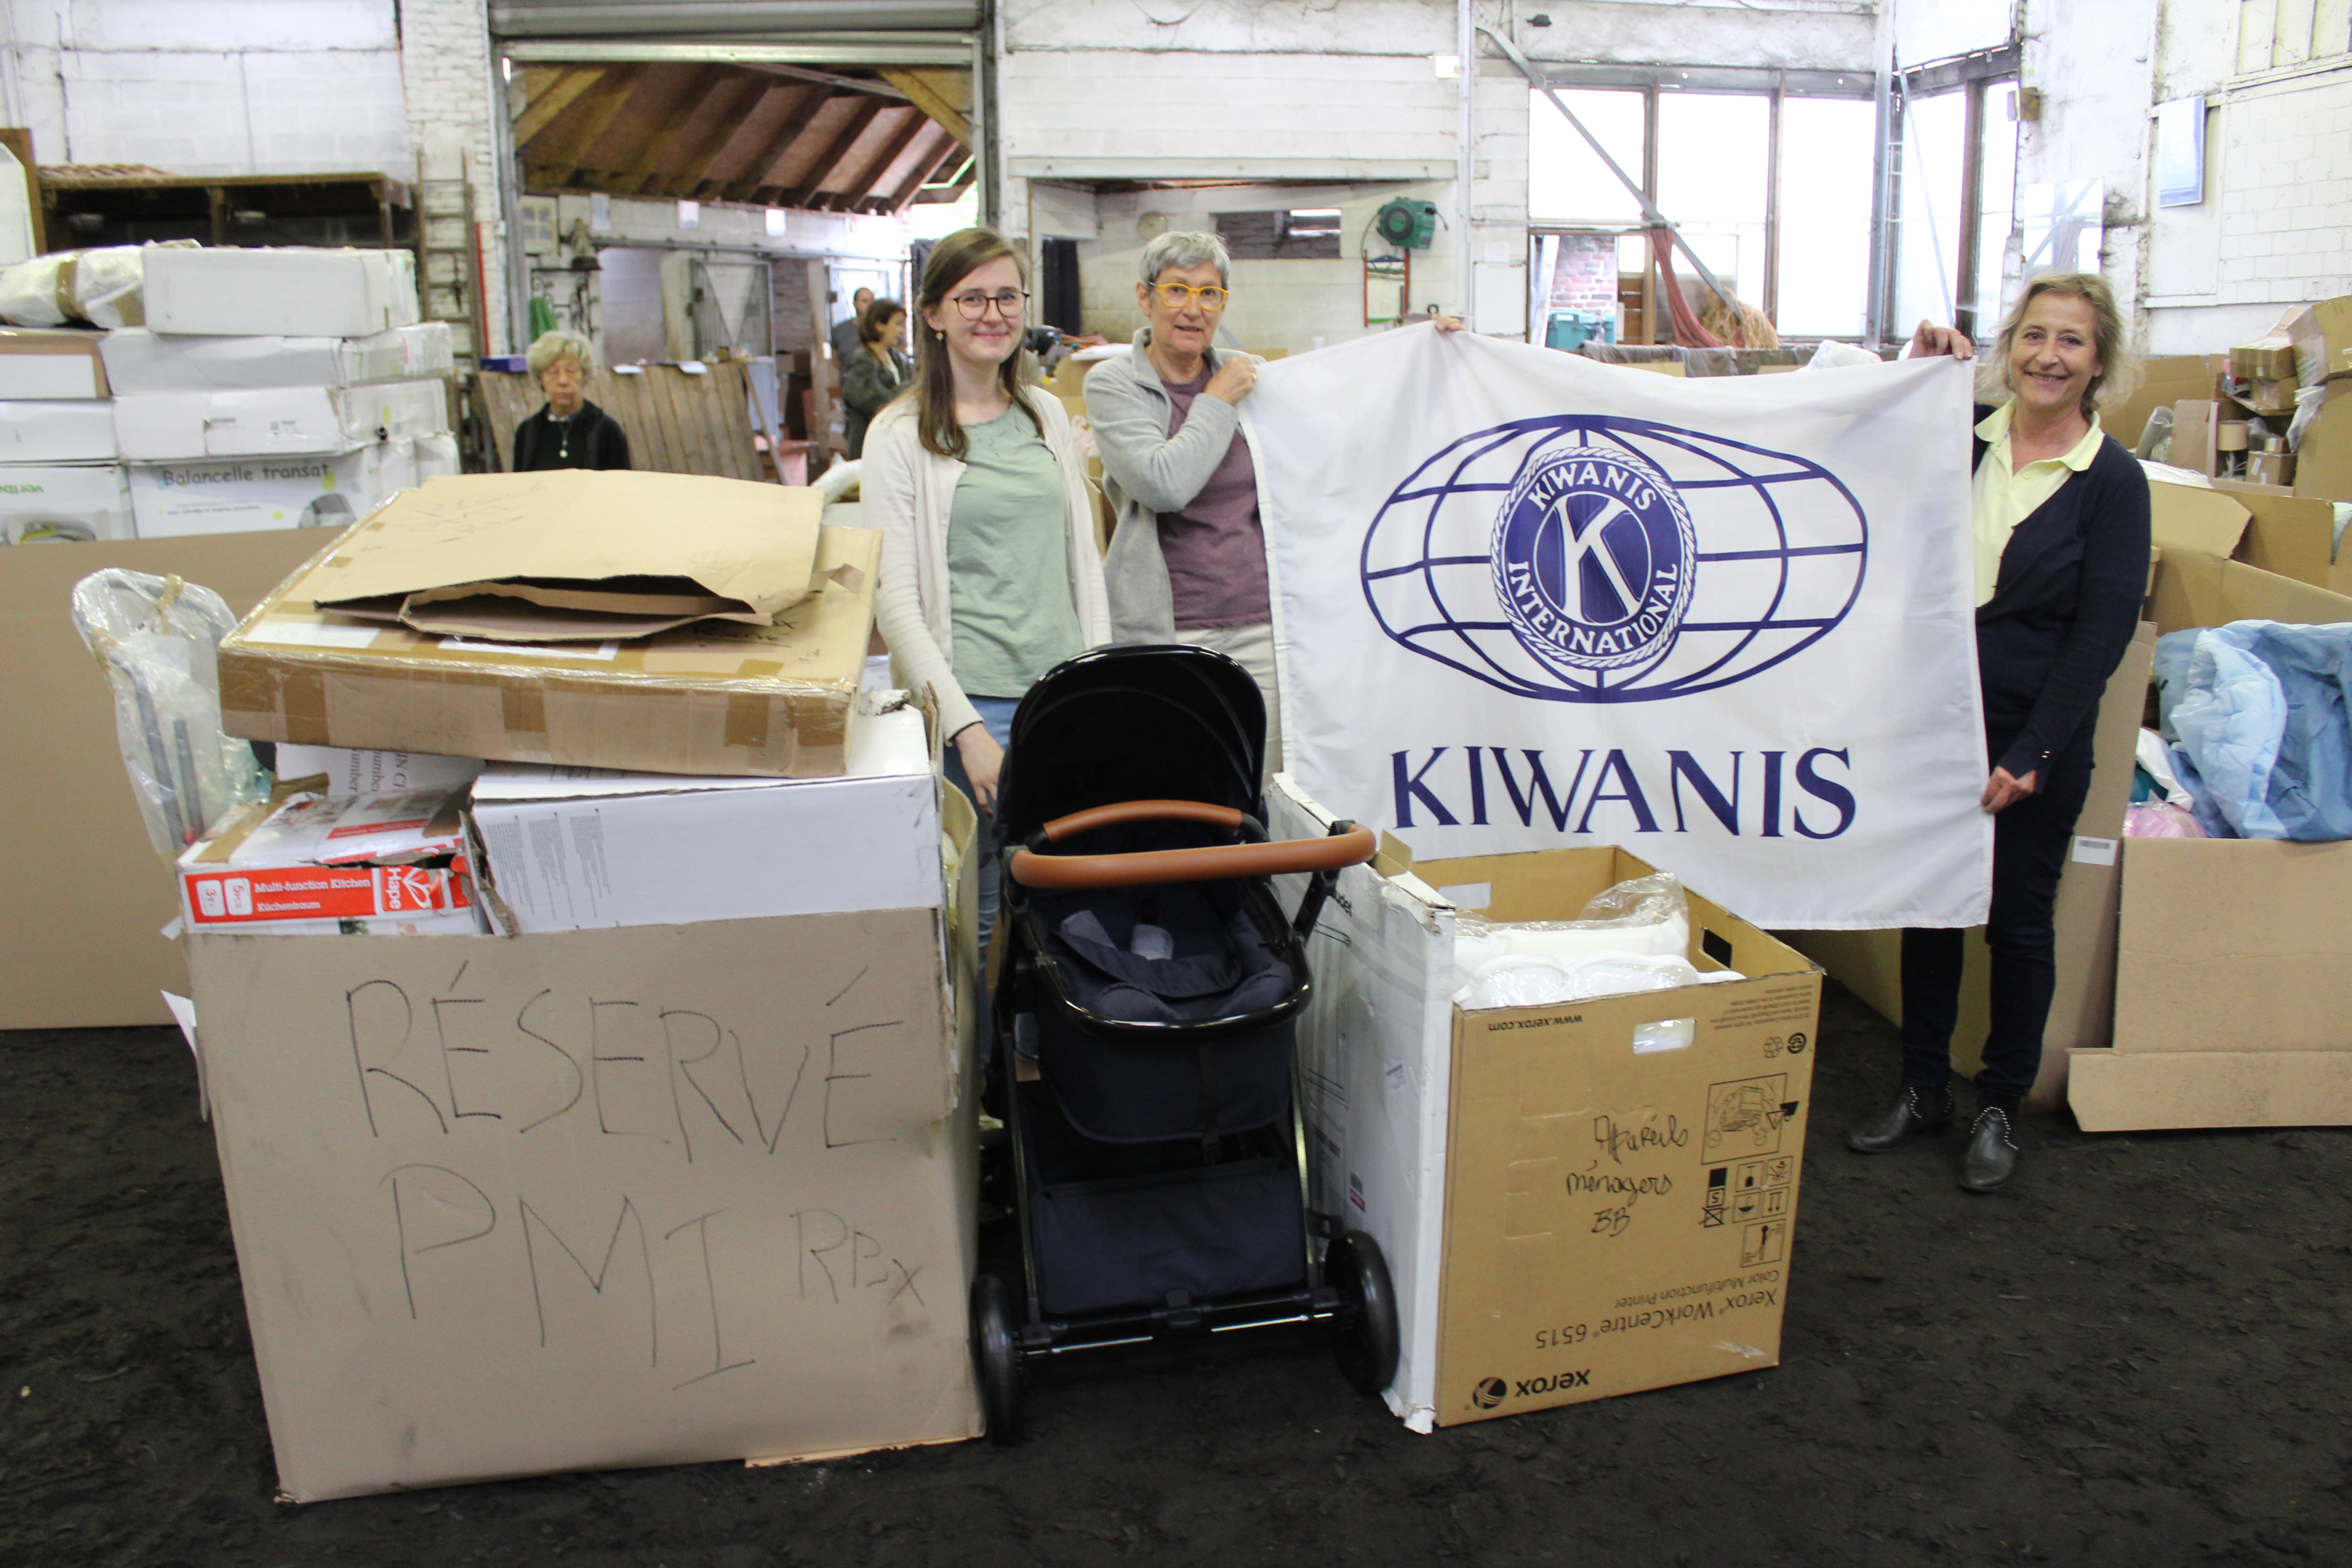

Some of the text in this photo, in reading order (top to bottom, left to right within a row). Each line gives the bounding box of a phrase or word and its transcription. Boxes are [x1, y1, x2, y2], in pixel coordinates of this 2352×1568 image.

[163, 462, 328, 486] Balancelle transat
[1528, 461, 1657, 511] KIWANIS
[1554, 493, 1643, 624] K
[1508, 561, 1678, 654] INTERNATIONAL
[1390, 746, 1856, 839] KIWANIS
[254, 878, 372, 893] Multi-function Kitchen
[386, 867, 402, 910] Hape
[1488, 1015, 1583, 1031] www.xerox.com
[346, 960, 904, 1163] RÉSERVÉ
[1591, 1207, 1631, 1238] BB
[377, 1163, 755, 1390] PMI
[1614, 1270, 1780, 1308] Color Multifunction Printer
[1535, 1323, 1587, 1349] 6515
[1515, 1369, 1591, 1397] xerox
